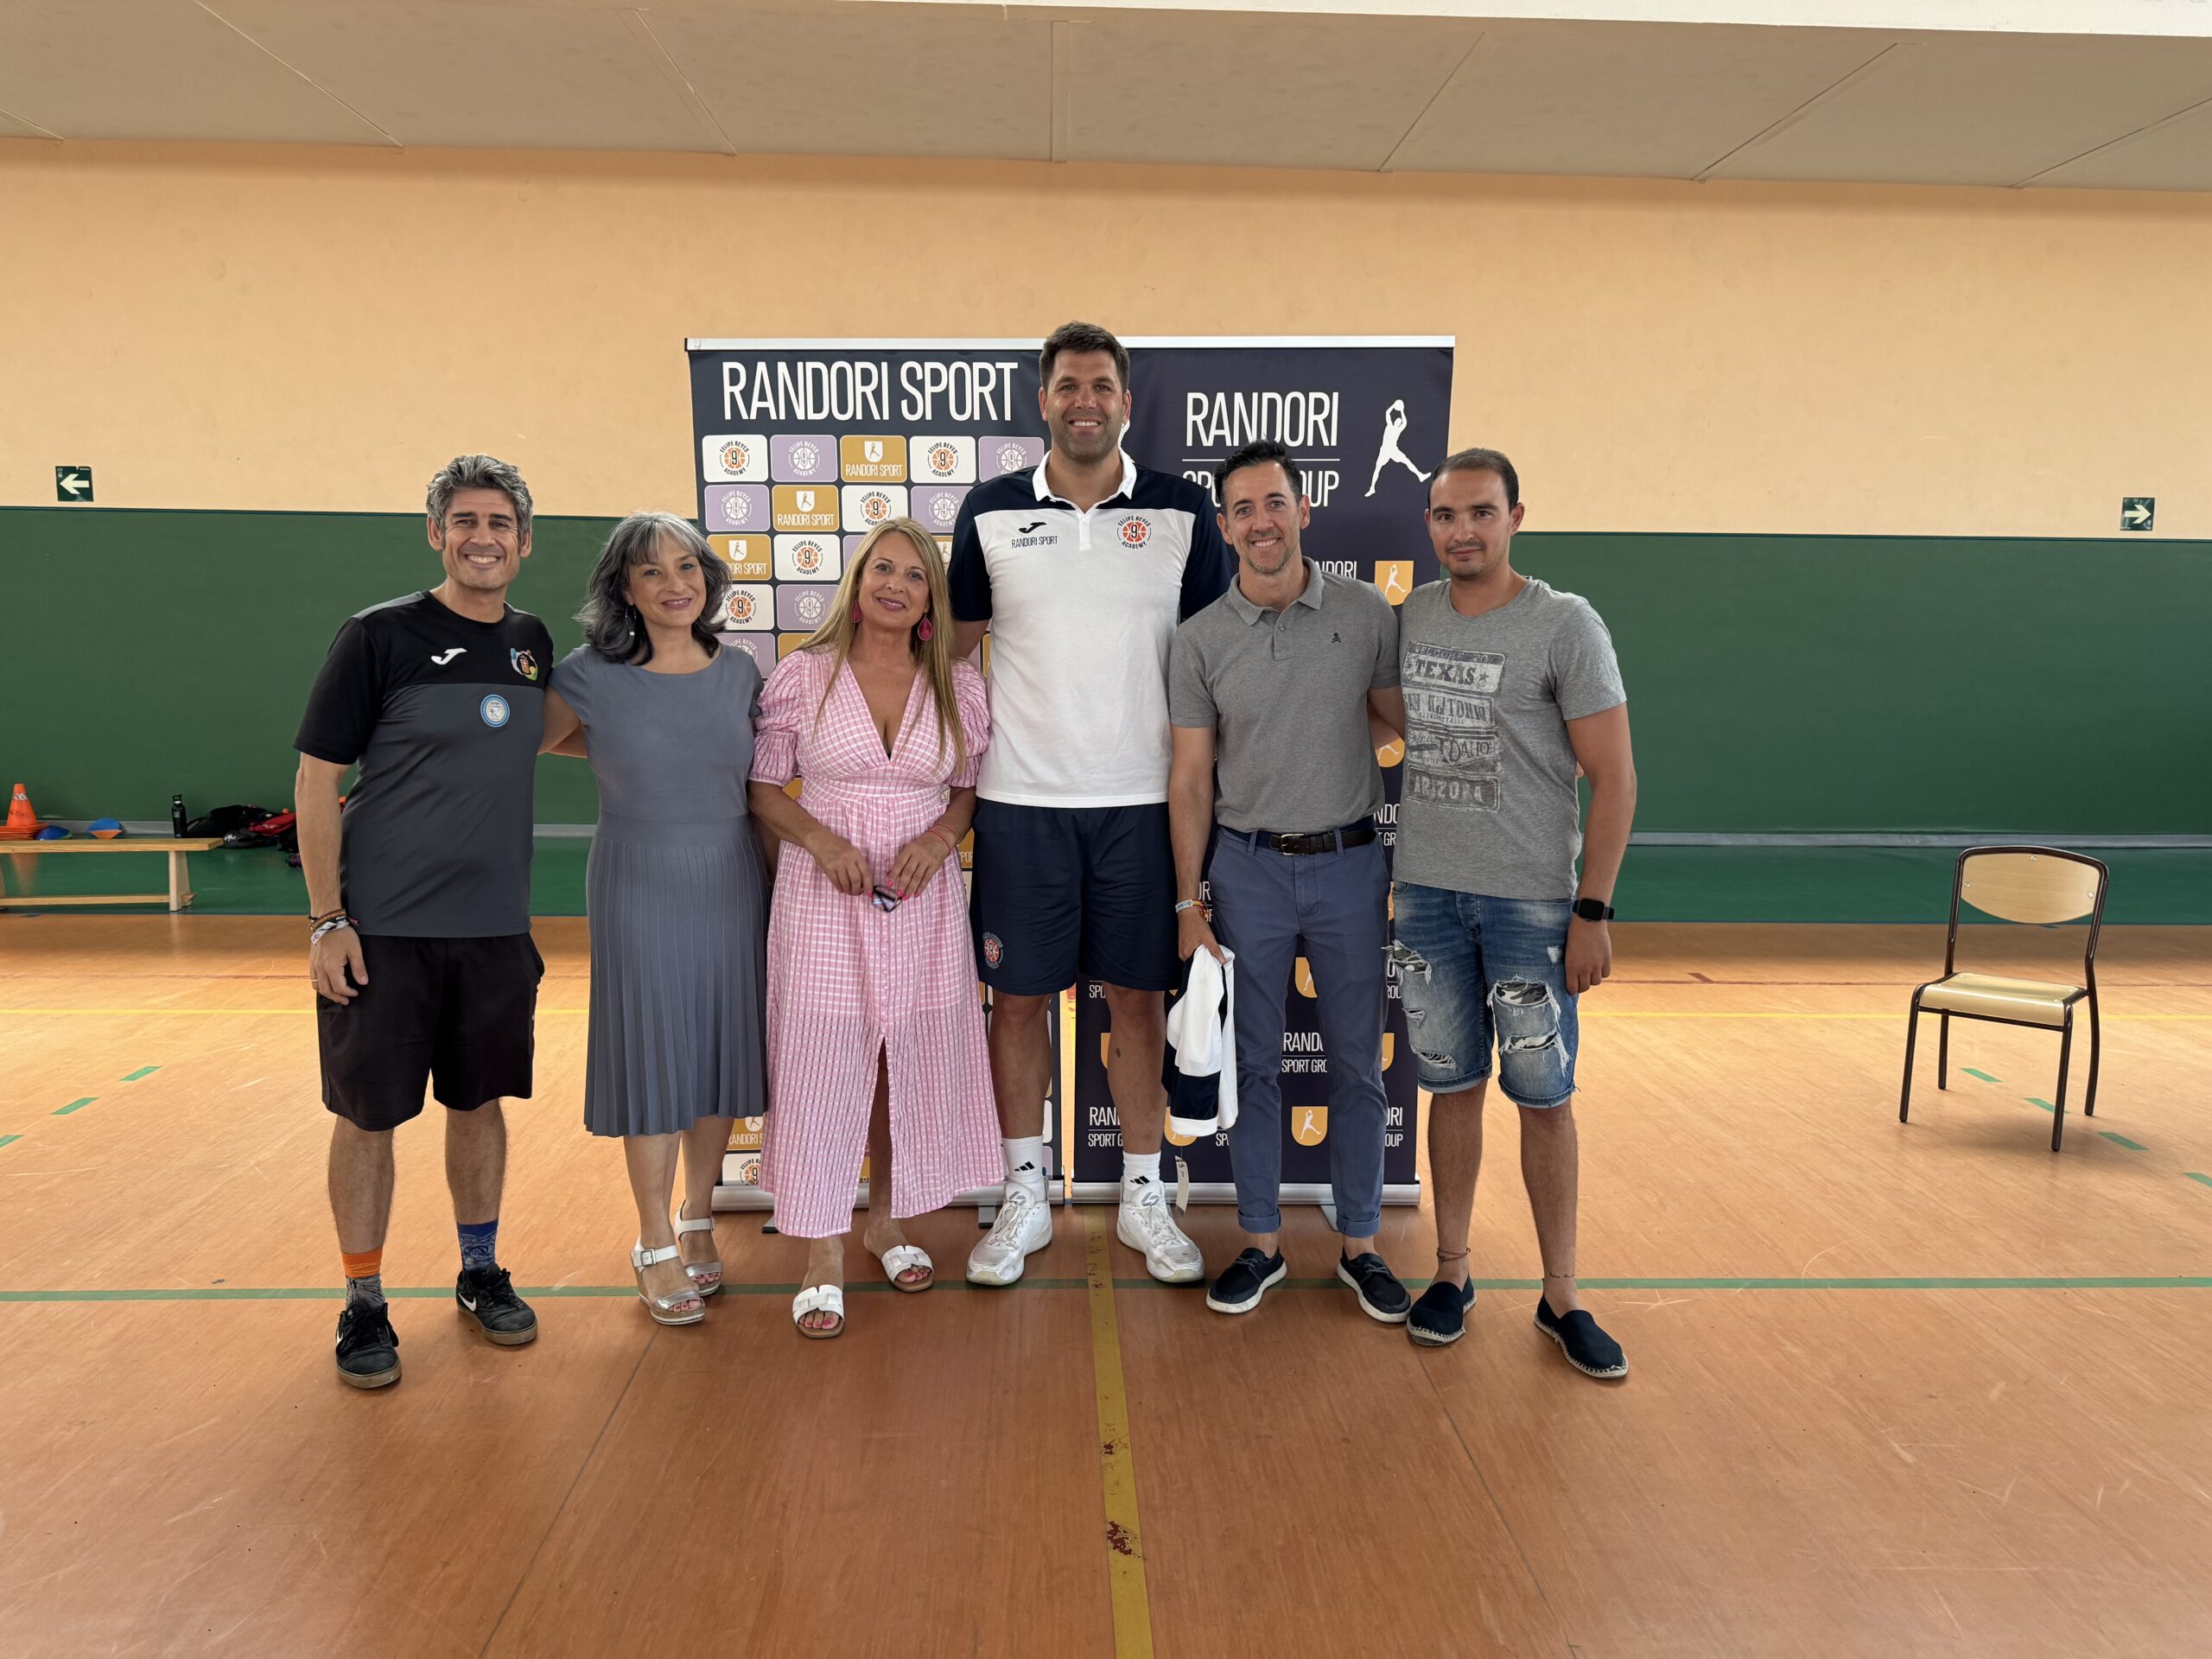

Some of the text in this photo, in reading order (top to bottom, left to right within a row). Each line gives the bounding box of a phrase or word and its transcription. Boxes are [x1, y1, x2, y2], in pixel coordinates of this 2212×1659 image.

[722, 361, 1018, 421] RANDORI SPORT
[1185, 391, 1338, 447] RANDORI
[720, 441, 749, 454] FELIPE REYES
[927, 442, 958, 454] FELIPE REYES
[732, 449, 738, 465] 9
[801, 449, 808, 466] 9
[939, 451, 946, 467] 9
[1008, 452, 1014, 467] 9
[724, 467, 747, 476] ACADEMY
[845, 464, 903, 477] RANDORI SPORT
[931, 468, 955, 478] ACADEMY
[860, 491, 874, 504] FELIPE
[872, 500, 879, 516] 9
[941, 500, 948, 517] 9
[777, 513, 835, 526] RANDORI SPORT
[1131, 524, 1138, 538] 9
[792, 540, 823, 553] FELIPE REYES
[1011, 535, 1058, 550] RANDORI SPORT
[1121, 540, 1147, 550] ACADEMY
[804, 550, 810, 564] 9
[743, 563, 767, 575] SPORT
[796, 567, 820, 575] ACADEMY
[737, 599, 744, 614] 9
[1415, 658, 1476, 685] TEXAS
[1283, 1032, 1324, 1052] RAND
[1281, 1058, 1328, 1073] SPORT GRO
[1088, 1133, 1116, 1147] SPORT
[1385, 1133, 1403, 1147] OUP
[740, 1158, 754, 1170] FELIPE
[752, 1166, 758, 1181] 9
